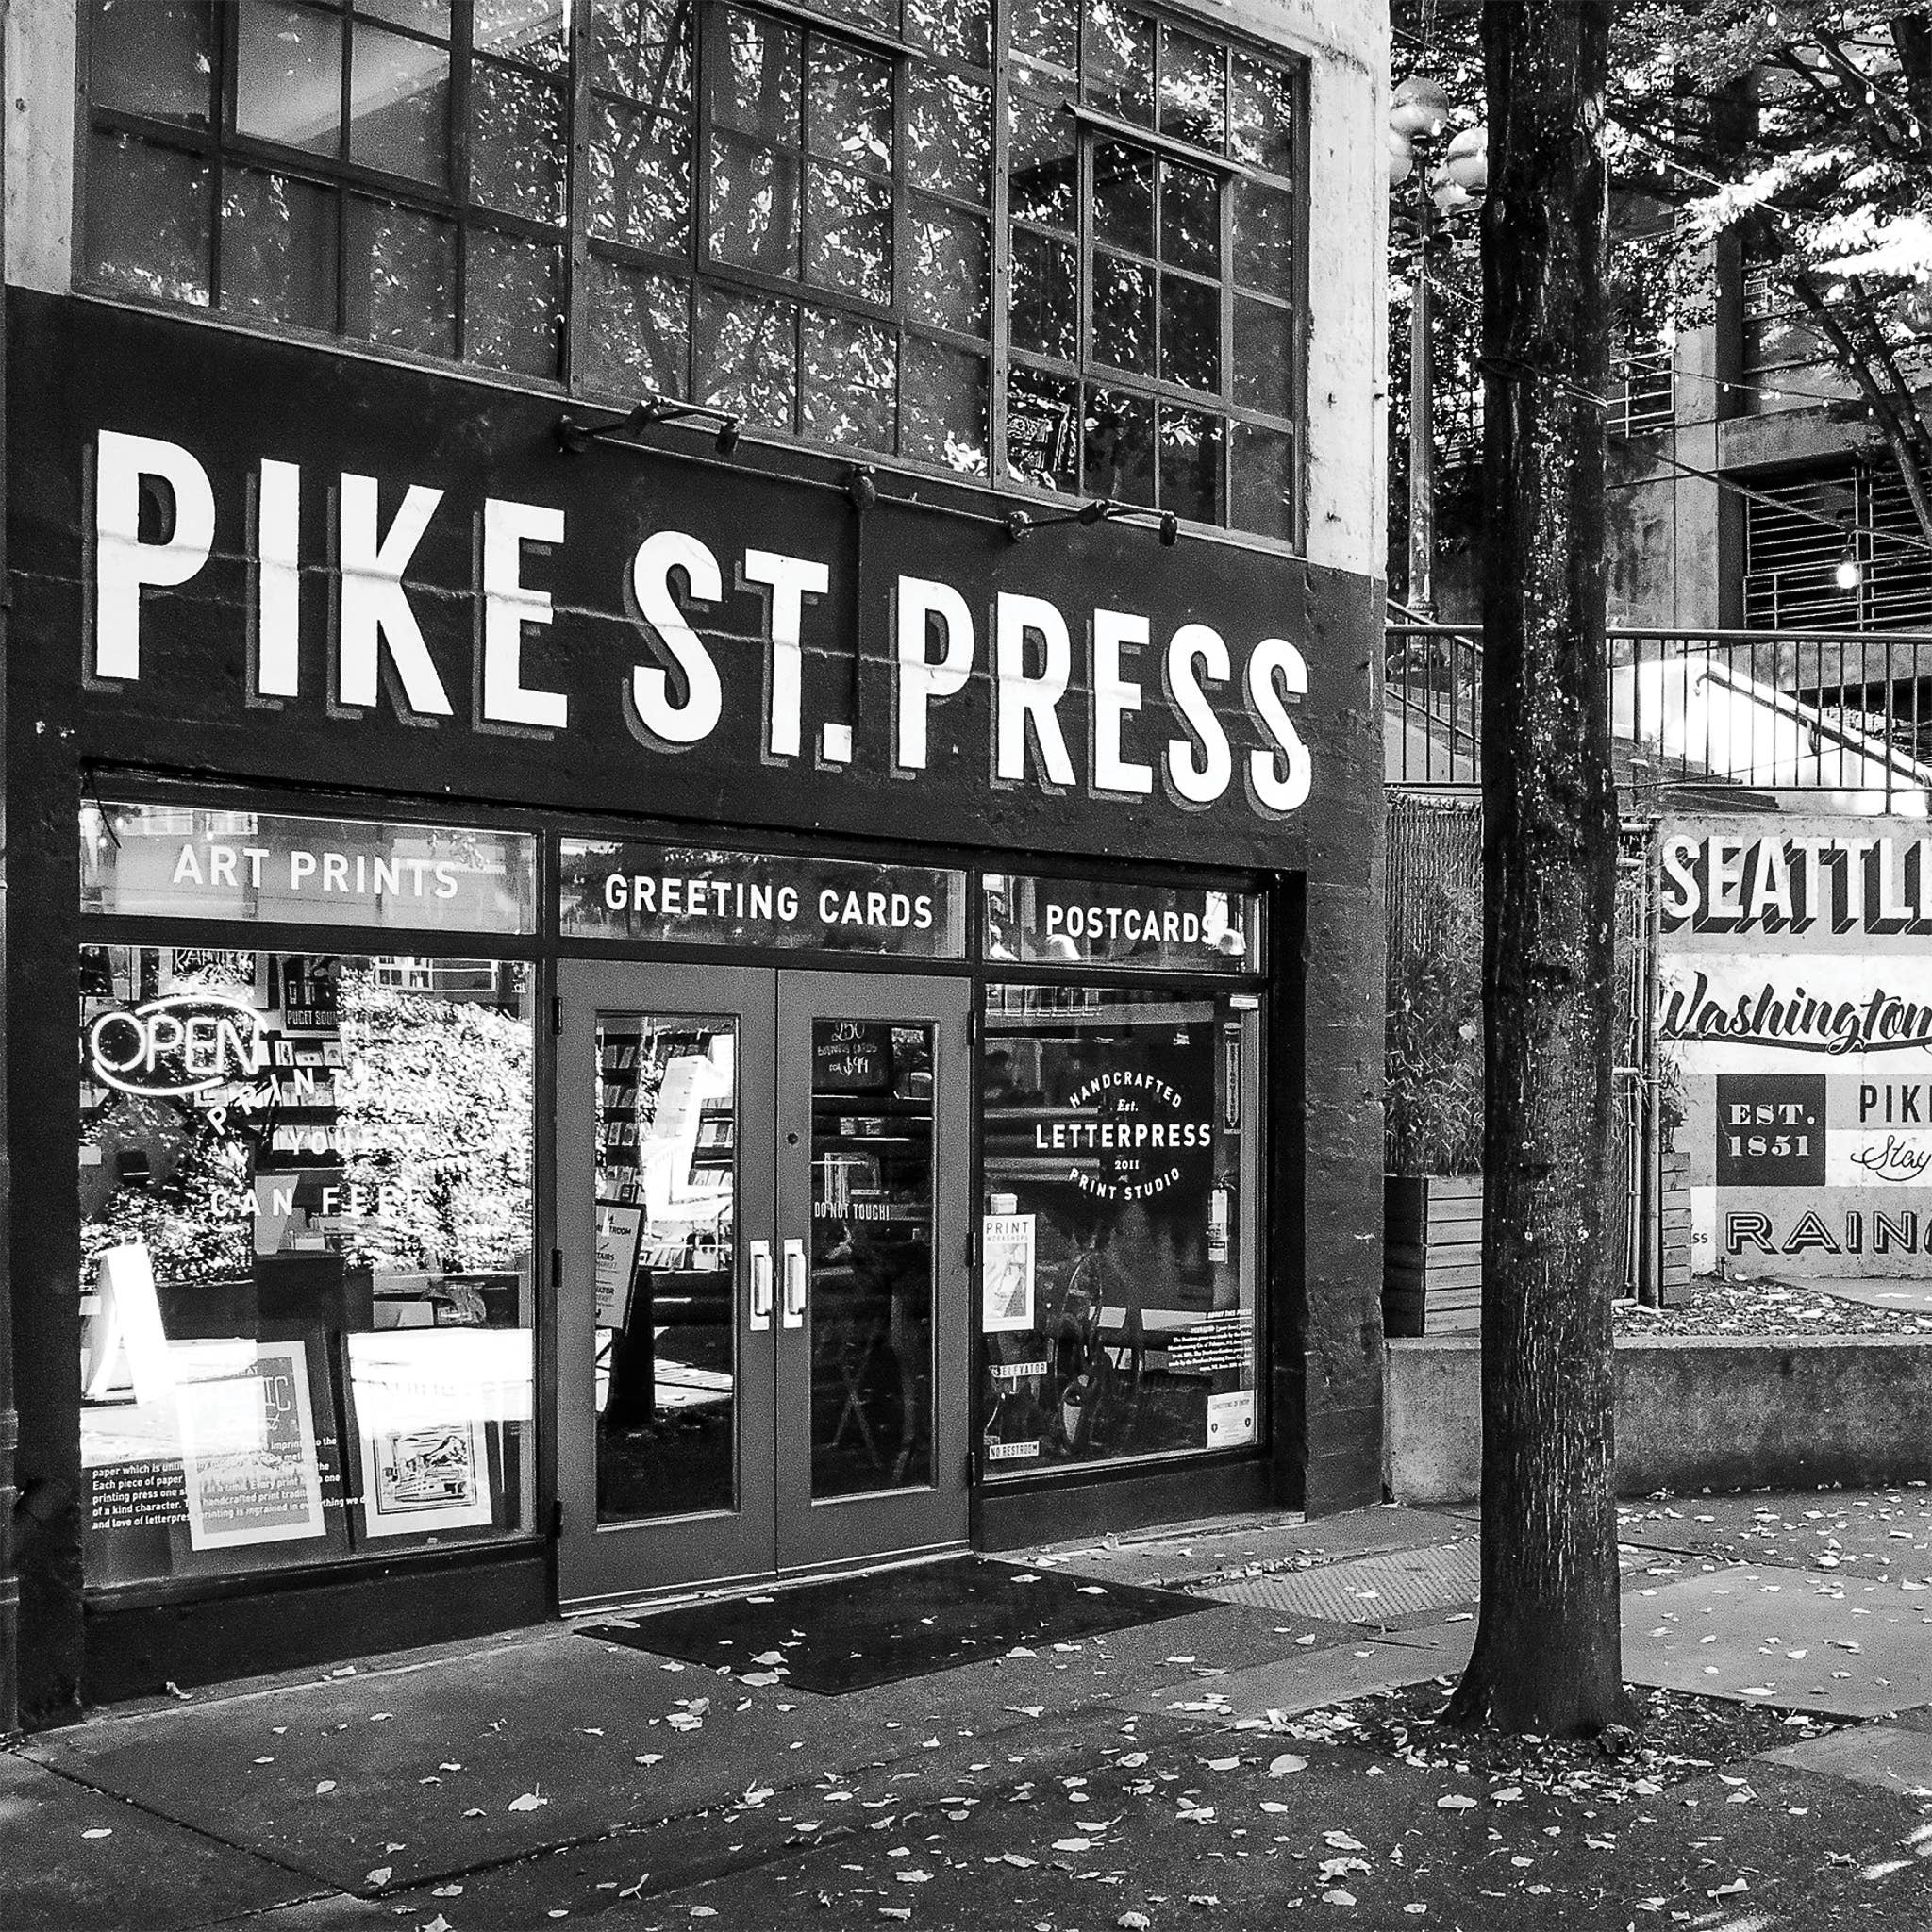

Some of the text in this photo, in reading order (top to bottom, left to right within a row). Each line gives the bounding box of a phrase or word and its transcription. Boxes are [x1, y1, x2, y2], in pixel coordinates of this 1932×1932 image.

[83, 429, 1312, 820] PIKE ST. PRESS
[173, 844, 458, 899] ART PRINTS
[605, 873, 934, 930] GREETING CARDS
[1046, 904, 1217, 944] POSTCARDS
[1659, 970, 1932, 1055] Washington
[91, 1011, 261, 1075] OPEN
[1069, 1070, 1182, 1108] HANDCRAFTED
[1116, 1098, 1139, 1112] Est.
[1728, 1104, 1815, 1125] EST.
[1859, 1084, 1932, 1123] PIK
[289, 1129, 350, 1156] YOU
[1036, 1123, 1213, 1149] LETTERPRESS
[1728, 1135, 1810, 1157] 1851
[1114, 1159, 1140, 1170] 2011
[1850, 1134, 1932, 1182] Stay
[1069, 1167, 1180, 1201] PRINT STUDIO
[209, 1187, 293, 1218] CAN
[814, 1201, 890, 1221] DO NOT TOUCH!
[986, 1221, 1029, 1234] PRINT
[1725, 1211, 1932, 1255] RAIN
[1002, 1363, 1046, 1376] ELEVATOR
[323, 1436, 337, 1445] the
[991, 1447, 1001, 1457] NO
[92, 1468, 121, 1479] paper
[123, 1463, 150, 1474] which
[92, 1479, 116, 1491] Each
[118, 1478, 142, 1490] piece
[144, 1475, 155, 1486] of
[157, 1474, 183, 1487] paper
[92, 1492, 130, 1506] printing
[132, 1490, 158, 1502] press
[160, 1489, 177, 1498] one
[325, 1474, 341, 1483] one
[92, 1507, 103, 1517] of
[112, 1505, 133, 1515] kind
[135, 1500, 182, 1513] character.
[92, 1519, 110, 1530] and
[112, 1517, 132, 1528] love
[133, 1515, 143, 1526] of
